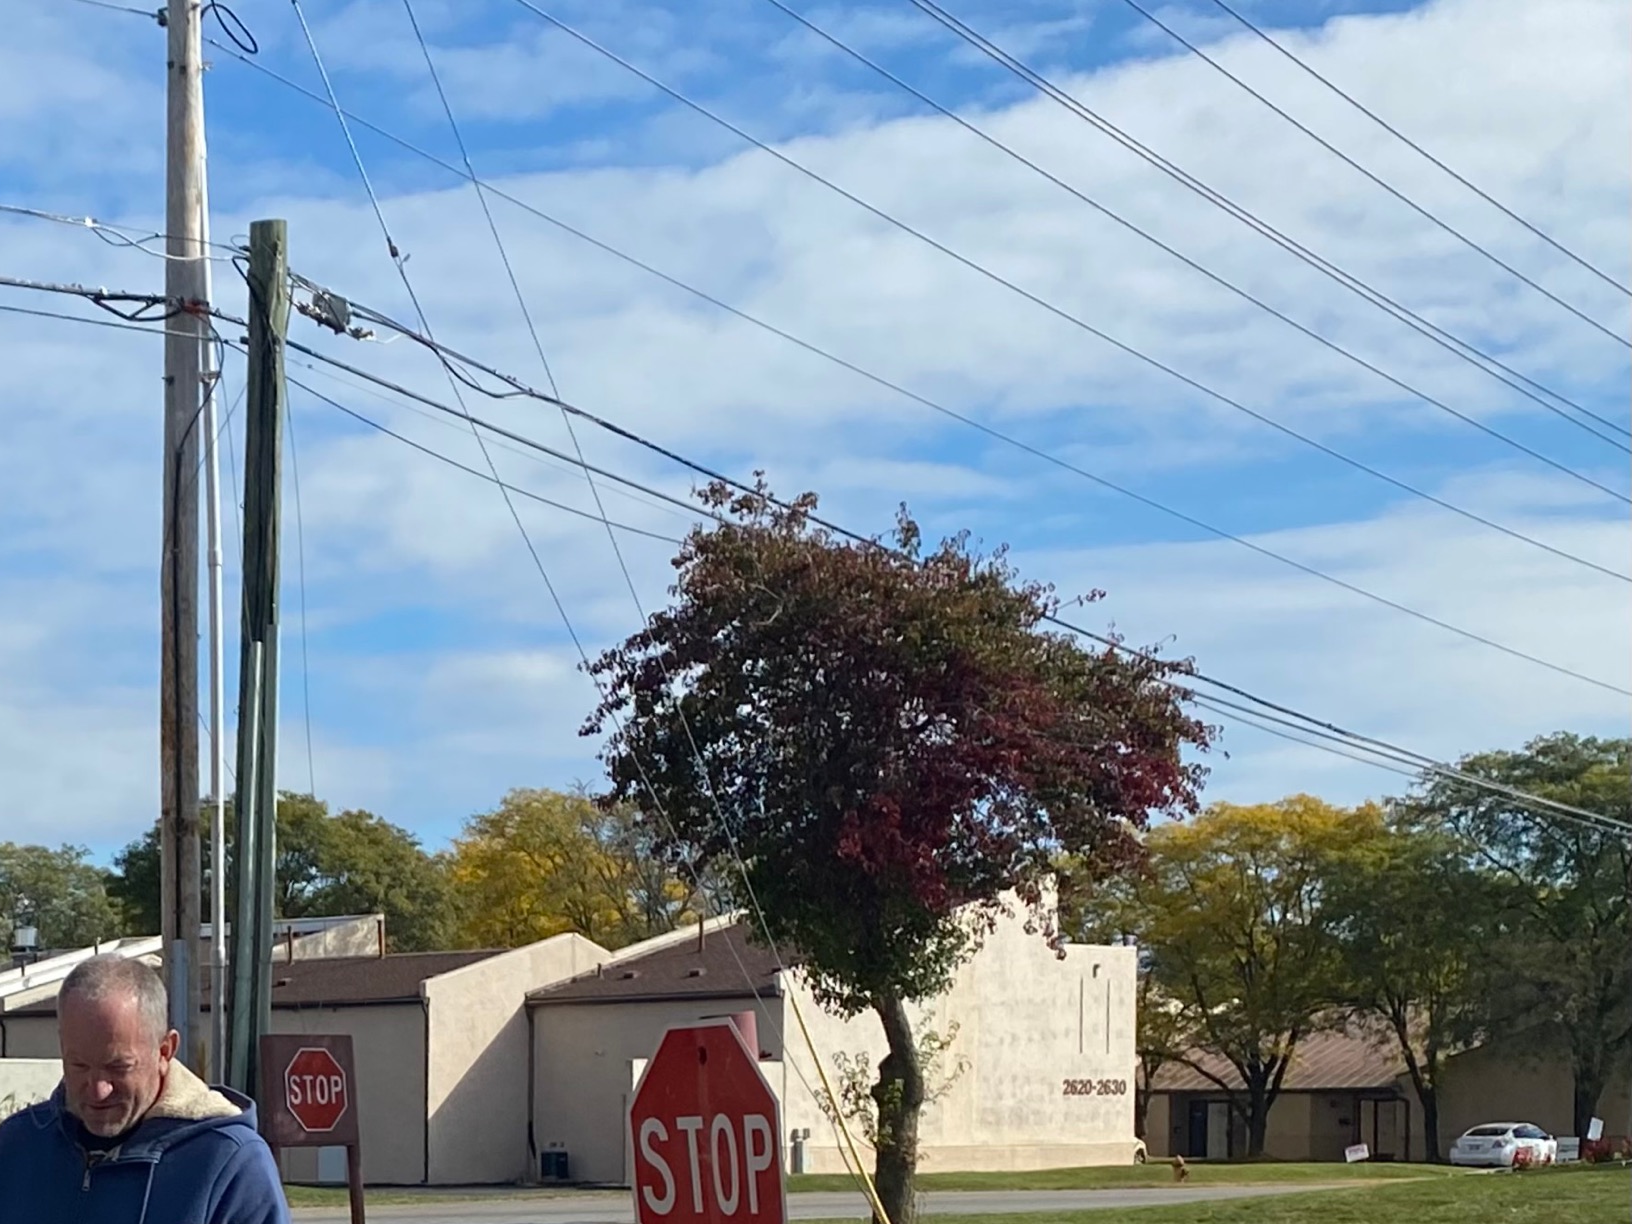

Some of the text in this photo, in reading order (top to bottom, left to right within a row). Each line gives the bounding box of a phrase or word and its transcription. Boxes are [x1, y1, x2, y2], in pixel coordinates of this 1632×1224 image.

[289, 1074, 342, 1105] STOP
[1062, 1078, 1127, 1096] 2620-2630
[639, 1113, 773, 1216] STOP
